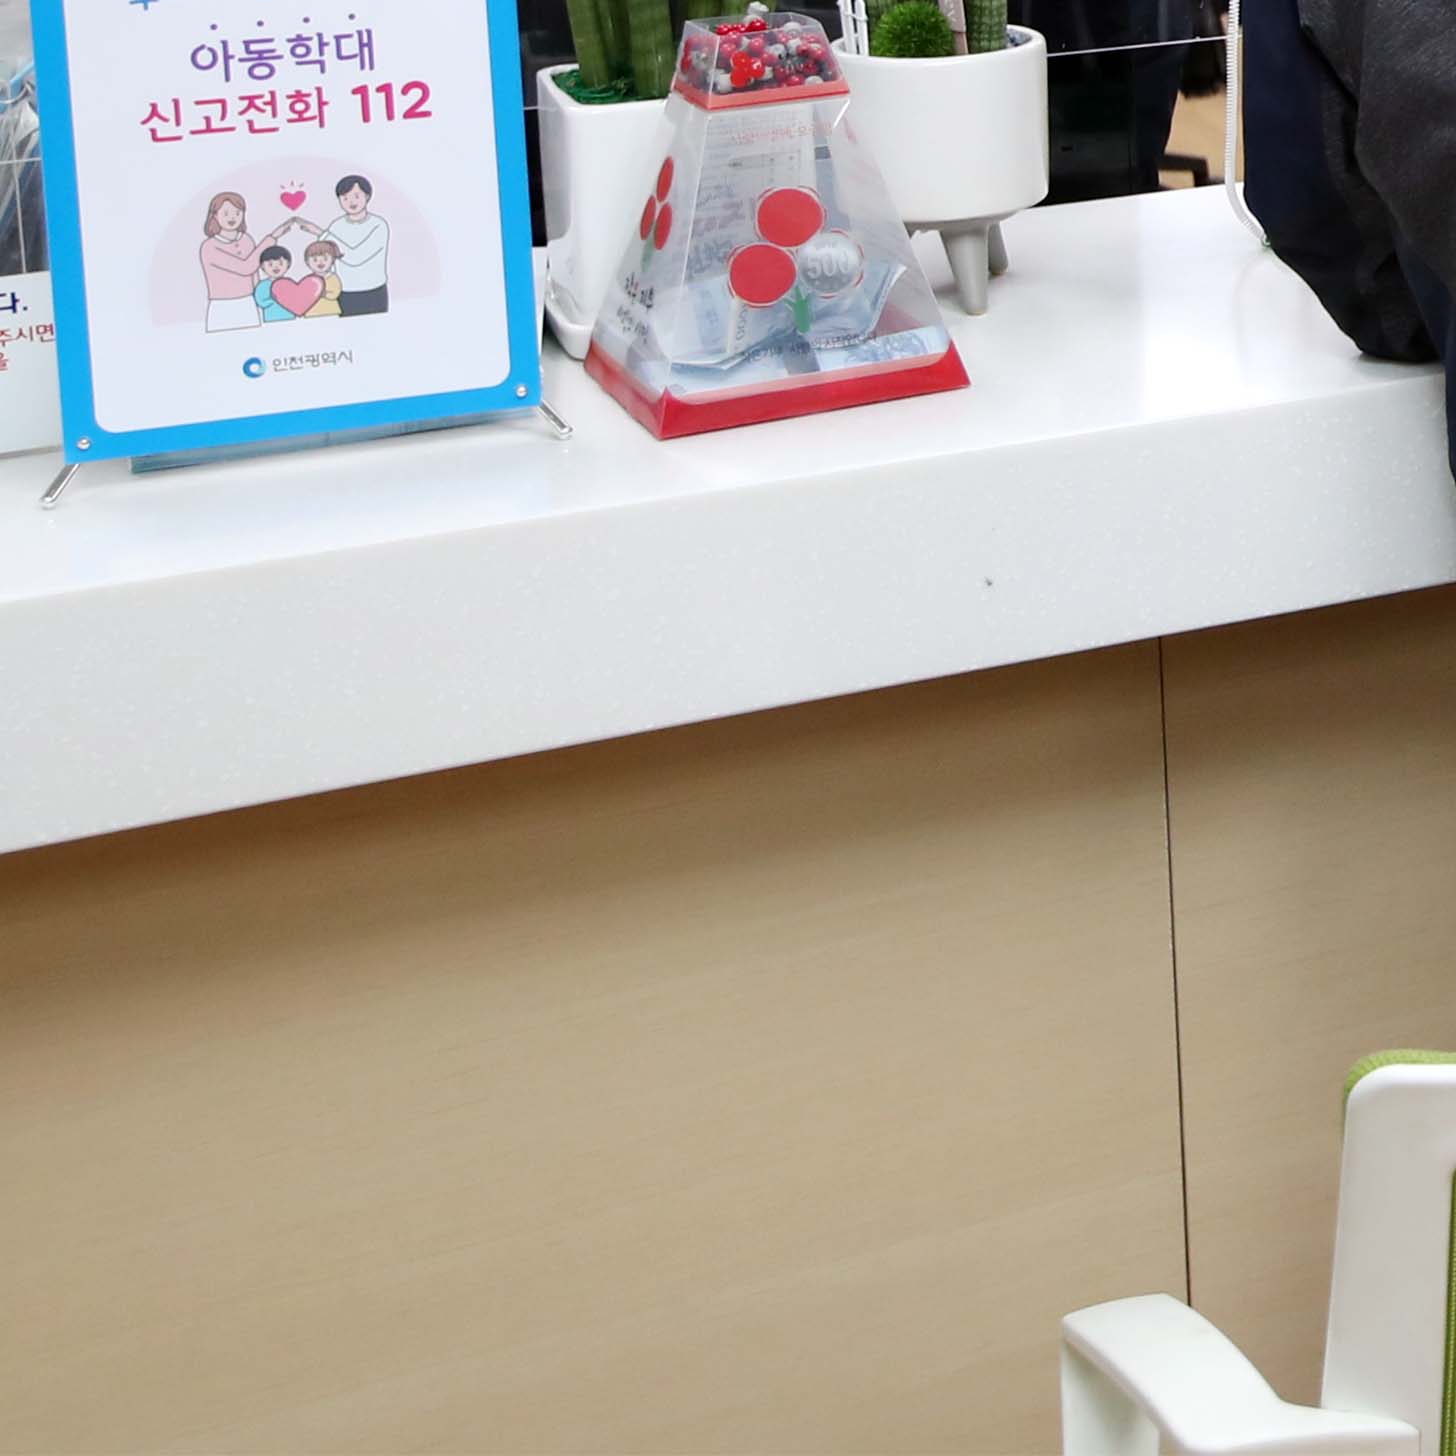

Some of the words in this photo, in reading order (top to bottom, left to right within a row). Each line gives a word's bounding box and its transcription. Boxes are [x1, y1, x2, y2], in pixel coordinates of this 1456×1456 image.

[189, 27, 378, 83] 아동학대
[138, 85, 330, 144] 신고전화
[350, 79, 433, 124] 112
[271, 348, 355, 373] 인천광역시
